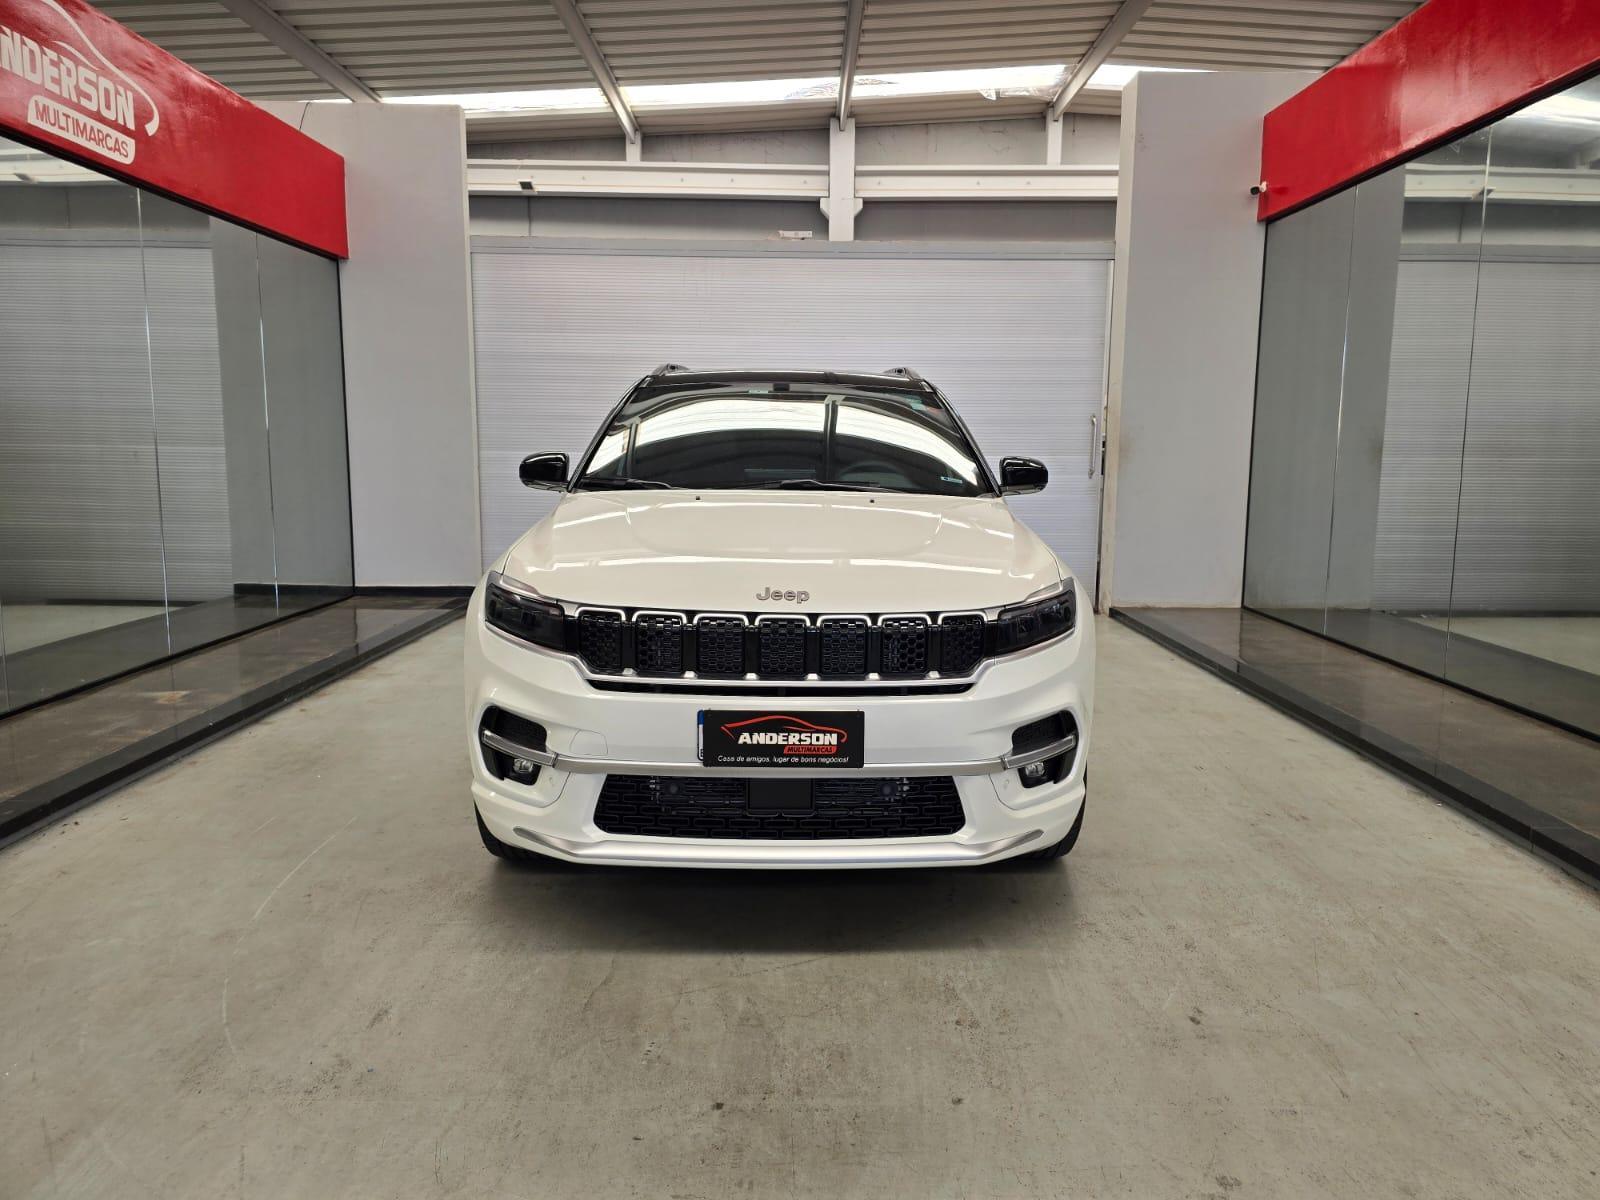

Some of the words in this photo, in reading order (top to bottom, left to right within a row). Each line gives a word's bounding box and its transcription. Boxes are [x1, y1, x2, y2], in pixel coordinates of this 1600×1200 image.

[0, 25, 136, 131] NDERSON
[34, 99, 129, 158] MULTIMARCAS
[756, 587, 810, 604] Jeep
[738, 732, 837, 745] ANDERSON
[773, 755, 790, 763] lugar
